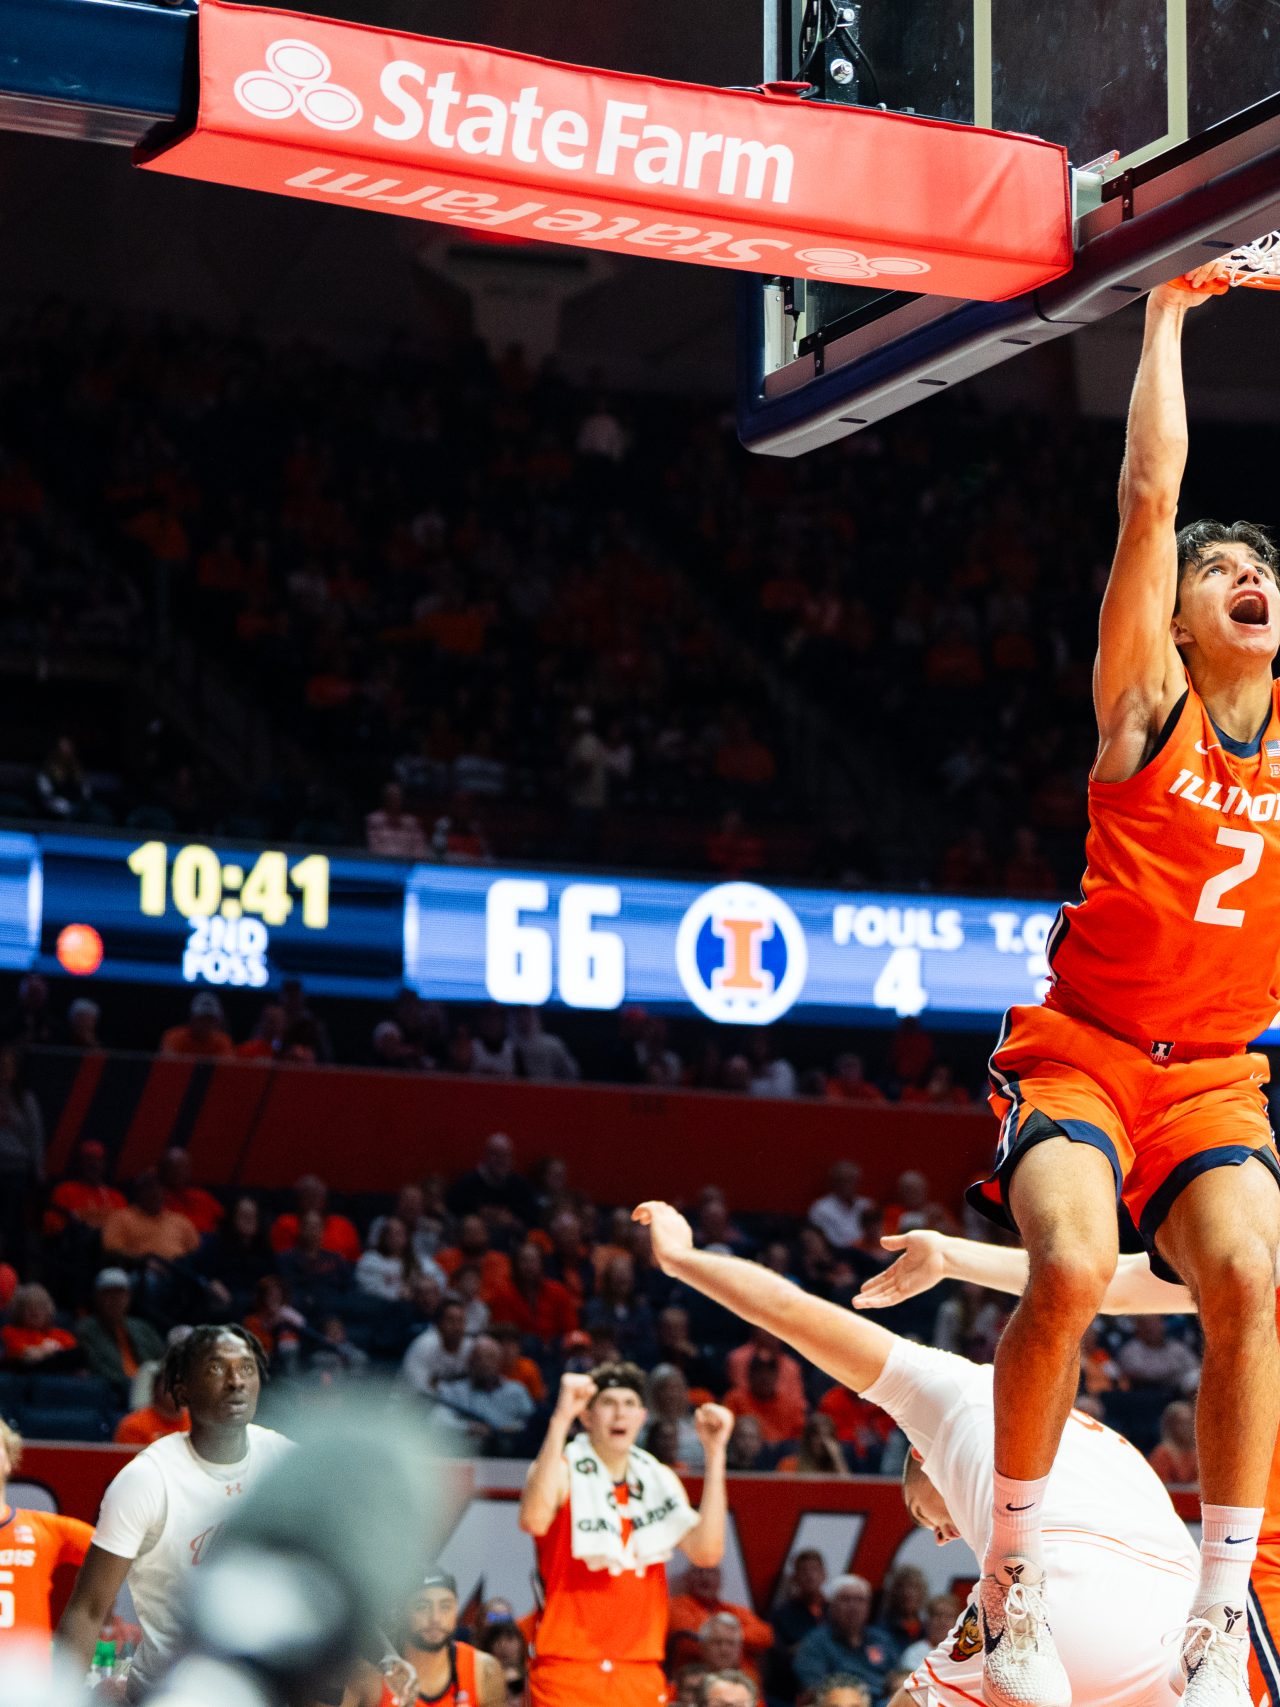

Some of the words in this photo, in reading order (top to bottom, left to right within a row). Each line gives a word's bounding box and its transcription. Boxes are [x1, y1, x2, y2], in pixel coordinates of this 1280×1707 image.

[127, 841, 330, 929] 10:41
[1194, 826, 1265, 928] 2
[187, 914, 269, 954] 2ND
[486, 878, 626, 1011] 66
[833, 904, 965, 951] FOULS
[873, 947, 929, 1018] 4
